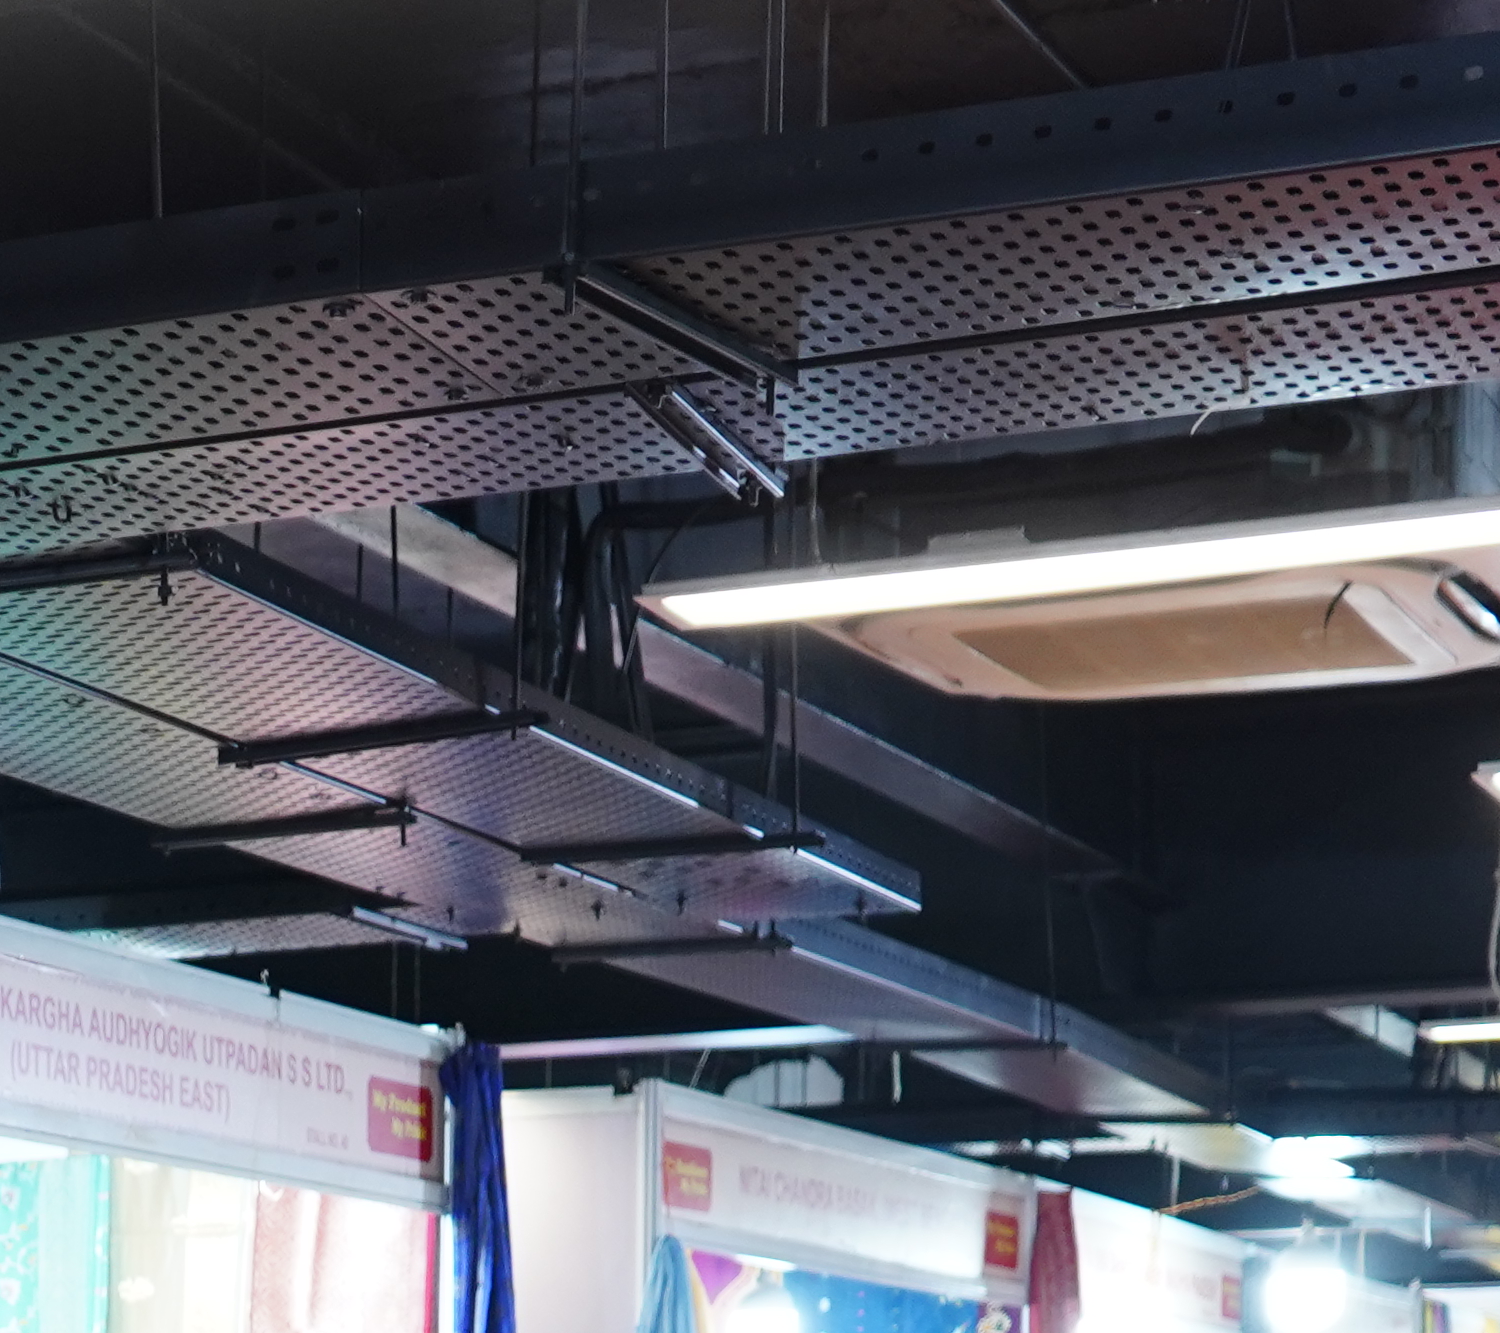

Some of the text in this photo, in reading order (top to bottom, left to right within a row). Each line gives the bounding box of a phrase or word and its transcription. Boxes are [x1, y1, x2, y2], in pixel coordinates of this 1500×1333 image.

[10, 1039, 231, 1125] (UTTAR PRADESH EAST)
[89, 1006, 198, 1063] AUDHYOGIK
[203, 1034, 283, 1081] UTPADAN
[287, 1053, 298, 1086] S
[302, 1056, 313, 1088] S
